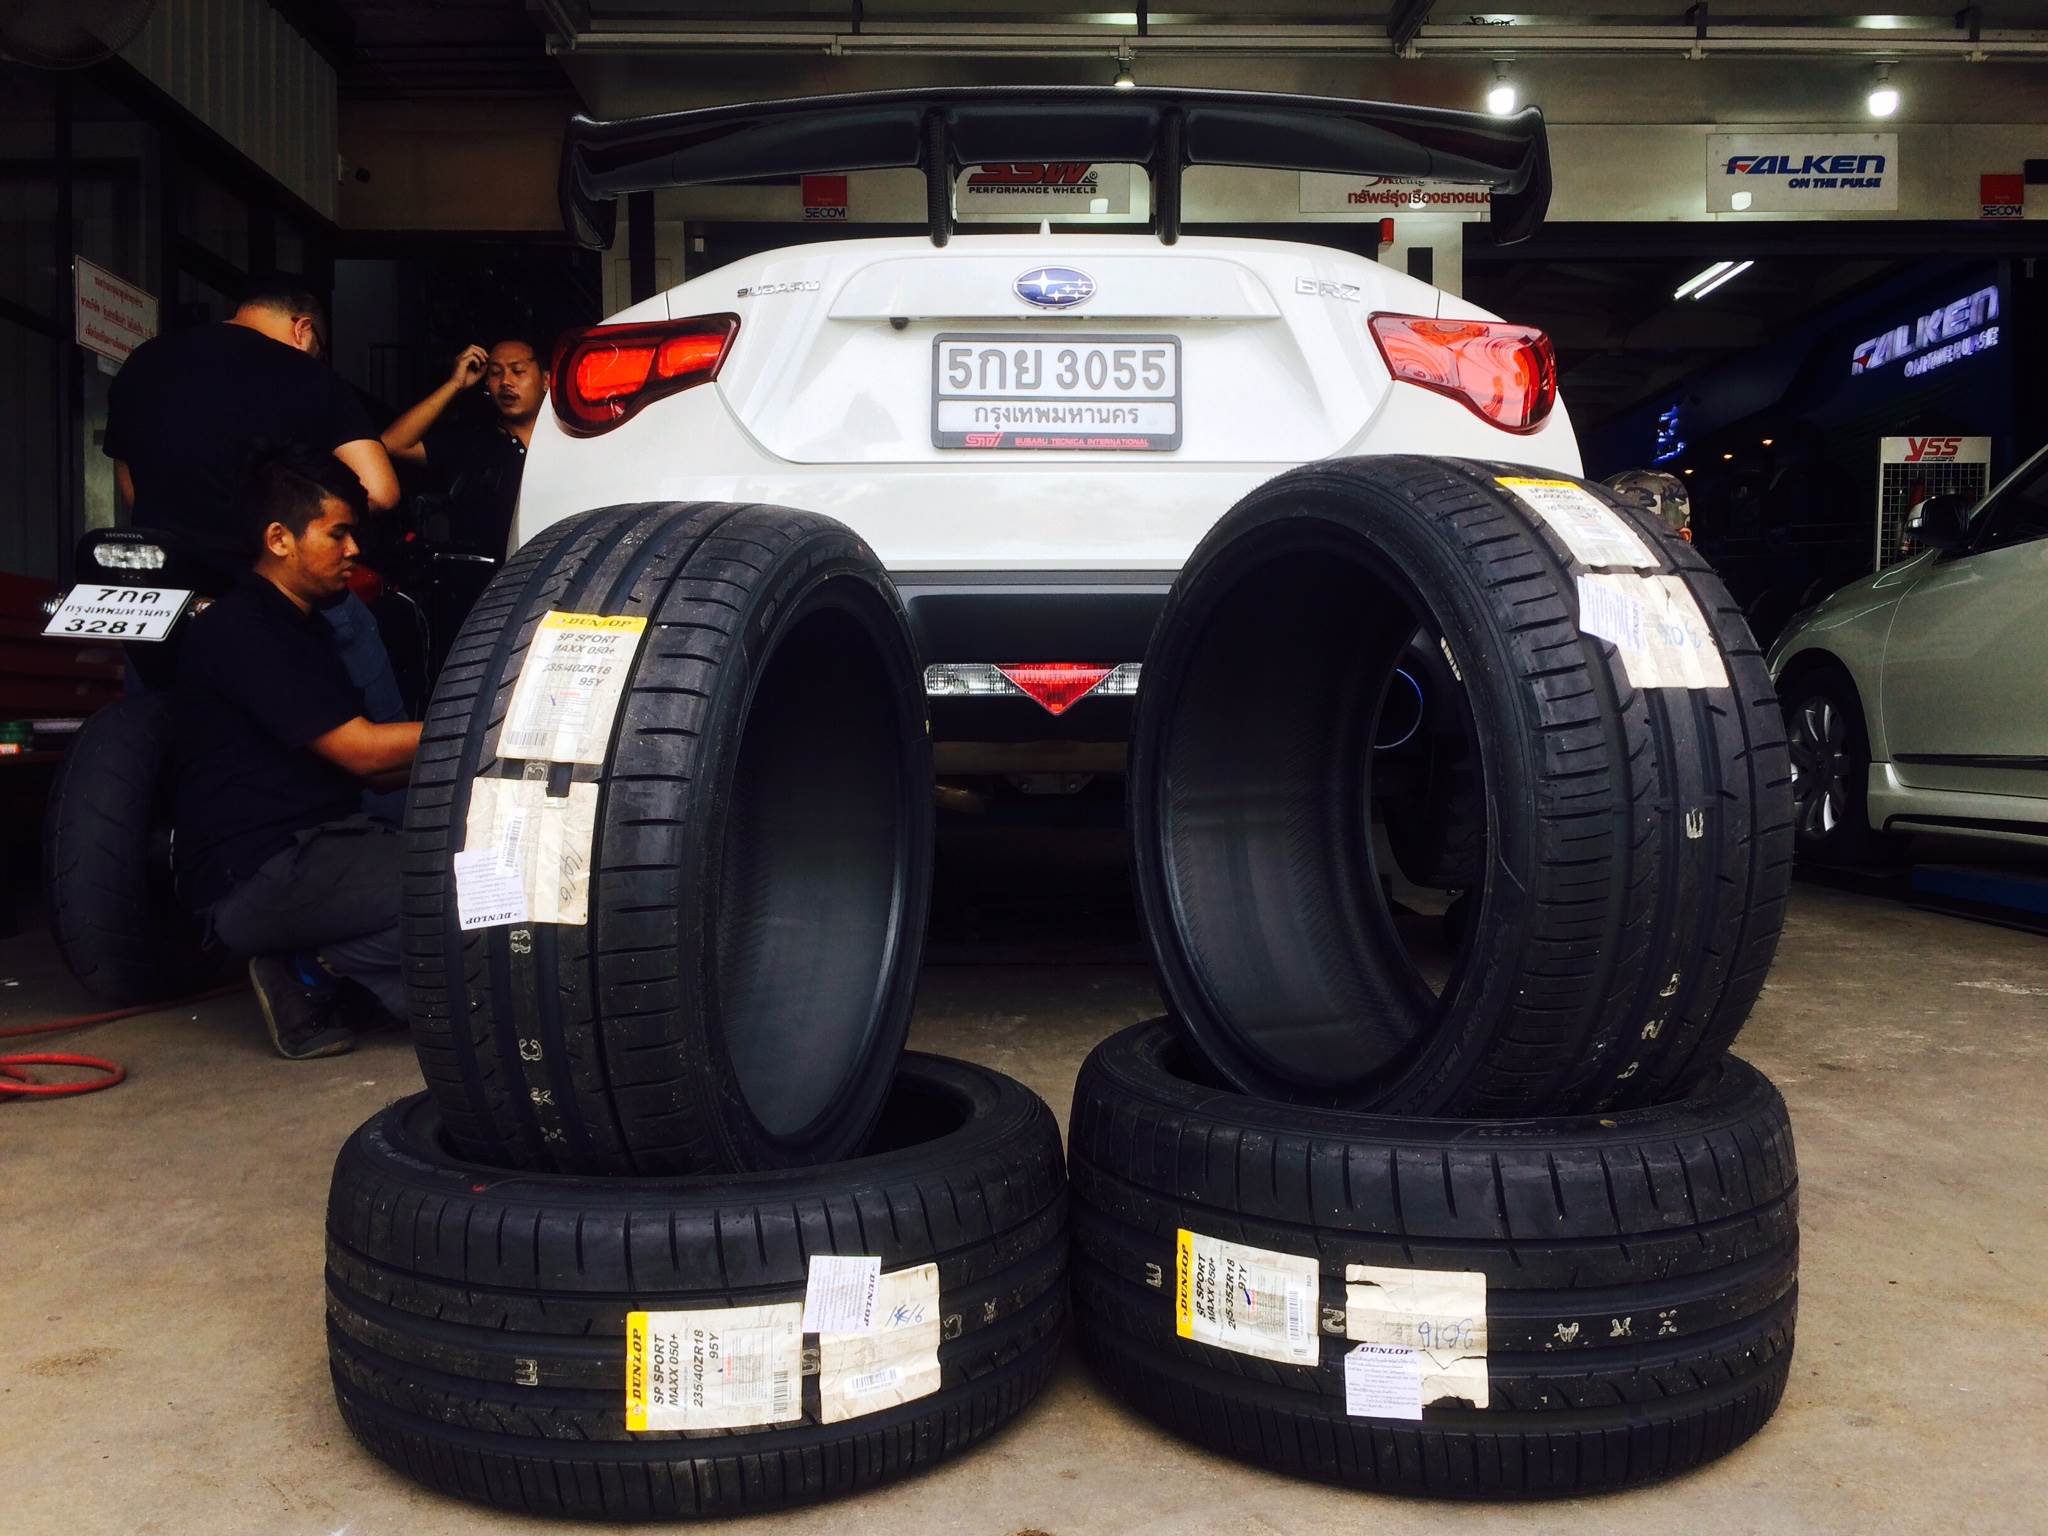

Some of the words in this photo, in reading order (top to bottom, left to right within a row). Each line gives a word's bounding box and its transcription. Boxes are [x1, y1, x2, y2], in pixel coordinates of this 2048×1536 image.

[1726, 155, 1886, 175] FALKEN
[968, 186, 1050, 194] PERFORMANCE
[1053, 186, 1097, 194] WHEELS
[1788, 178, 1810, 189] ON
[1813, 178, 1838, 189] THE
[1840, 178, 1882, 189] PULSE
[804, 207, 846, 218] SECOM
[1982, 205, 2022, 216] SECOM
[737, 280, 820, 298] SUBARU
[1295, 277, 1361, 303] BRZ
[1851, 285, 1999, 376] FALKEN
[948, 348, 1042, 390] 5กย
[1056, 349, 1166, 391] 3055
[974, 406, 1139, 430] กรุงเทพมหานคร
[1014, 437, 1049, 447] SUBARU
[1087, 438, 1150, 448] INTERNATIONAL
[65, 604, 174, 618] กรุงเทพมหานคร
[64, 618, 148, 636] 3281
[558, 633, 575, 642] SP
[575, 634, 622, 645] SPORT
[578, 677, 605, 687] 95Y
[465, 911, 513, 925] DUNLOP
[1180, 1244, 1191, 1312] DUNLOP
[1196, 1253, 1207, 1300] SPORT
[1207, 1257, 1218, 1286] 050+
[1238, 1264, 1249, 1291] 97Y
[863, 1273, 876, 1327] DUNLOP
[1195, 1301, 1207, 1319] SP
[1207, 1288, 1217, 1324] MAXX
[668, 1333, 680, 1366] 050+
[708, 1332, 720, 1360] 95Y
[1359, 1345, 1415, 1356] DUNLOP
[632, 1328, 643, 1401] DUNLOP
[653, 1334, 666, 1385] SPORT
[692, 1329, 705, 1409] 235/40ZR18
[653, 1387, 665, 1405] SP
[668, 1368, 681, 1408] MAXX
